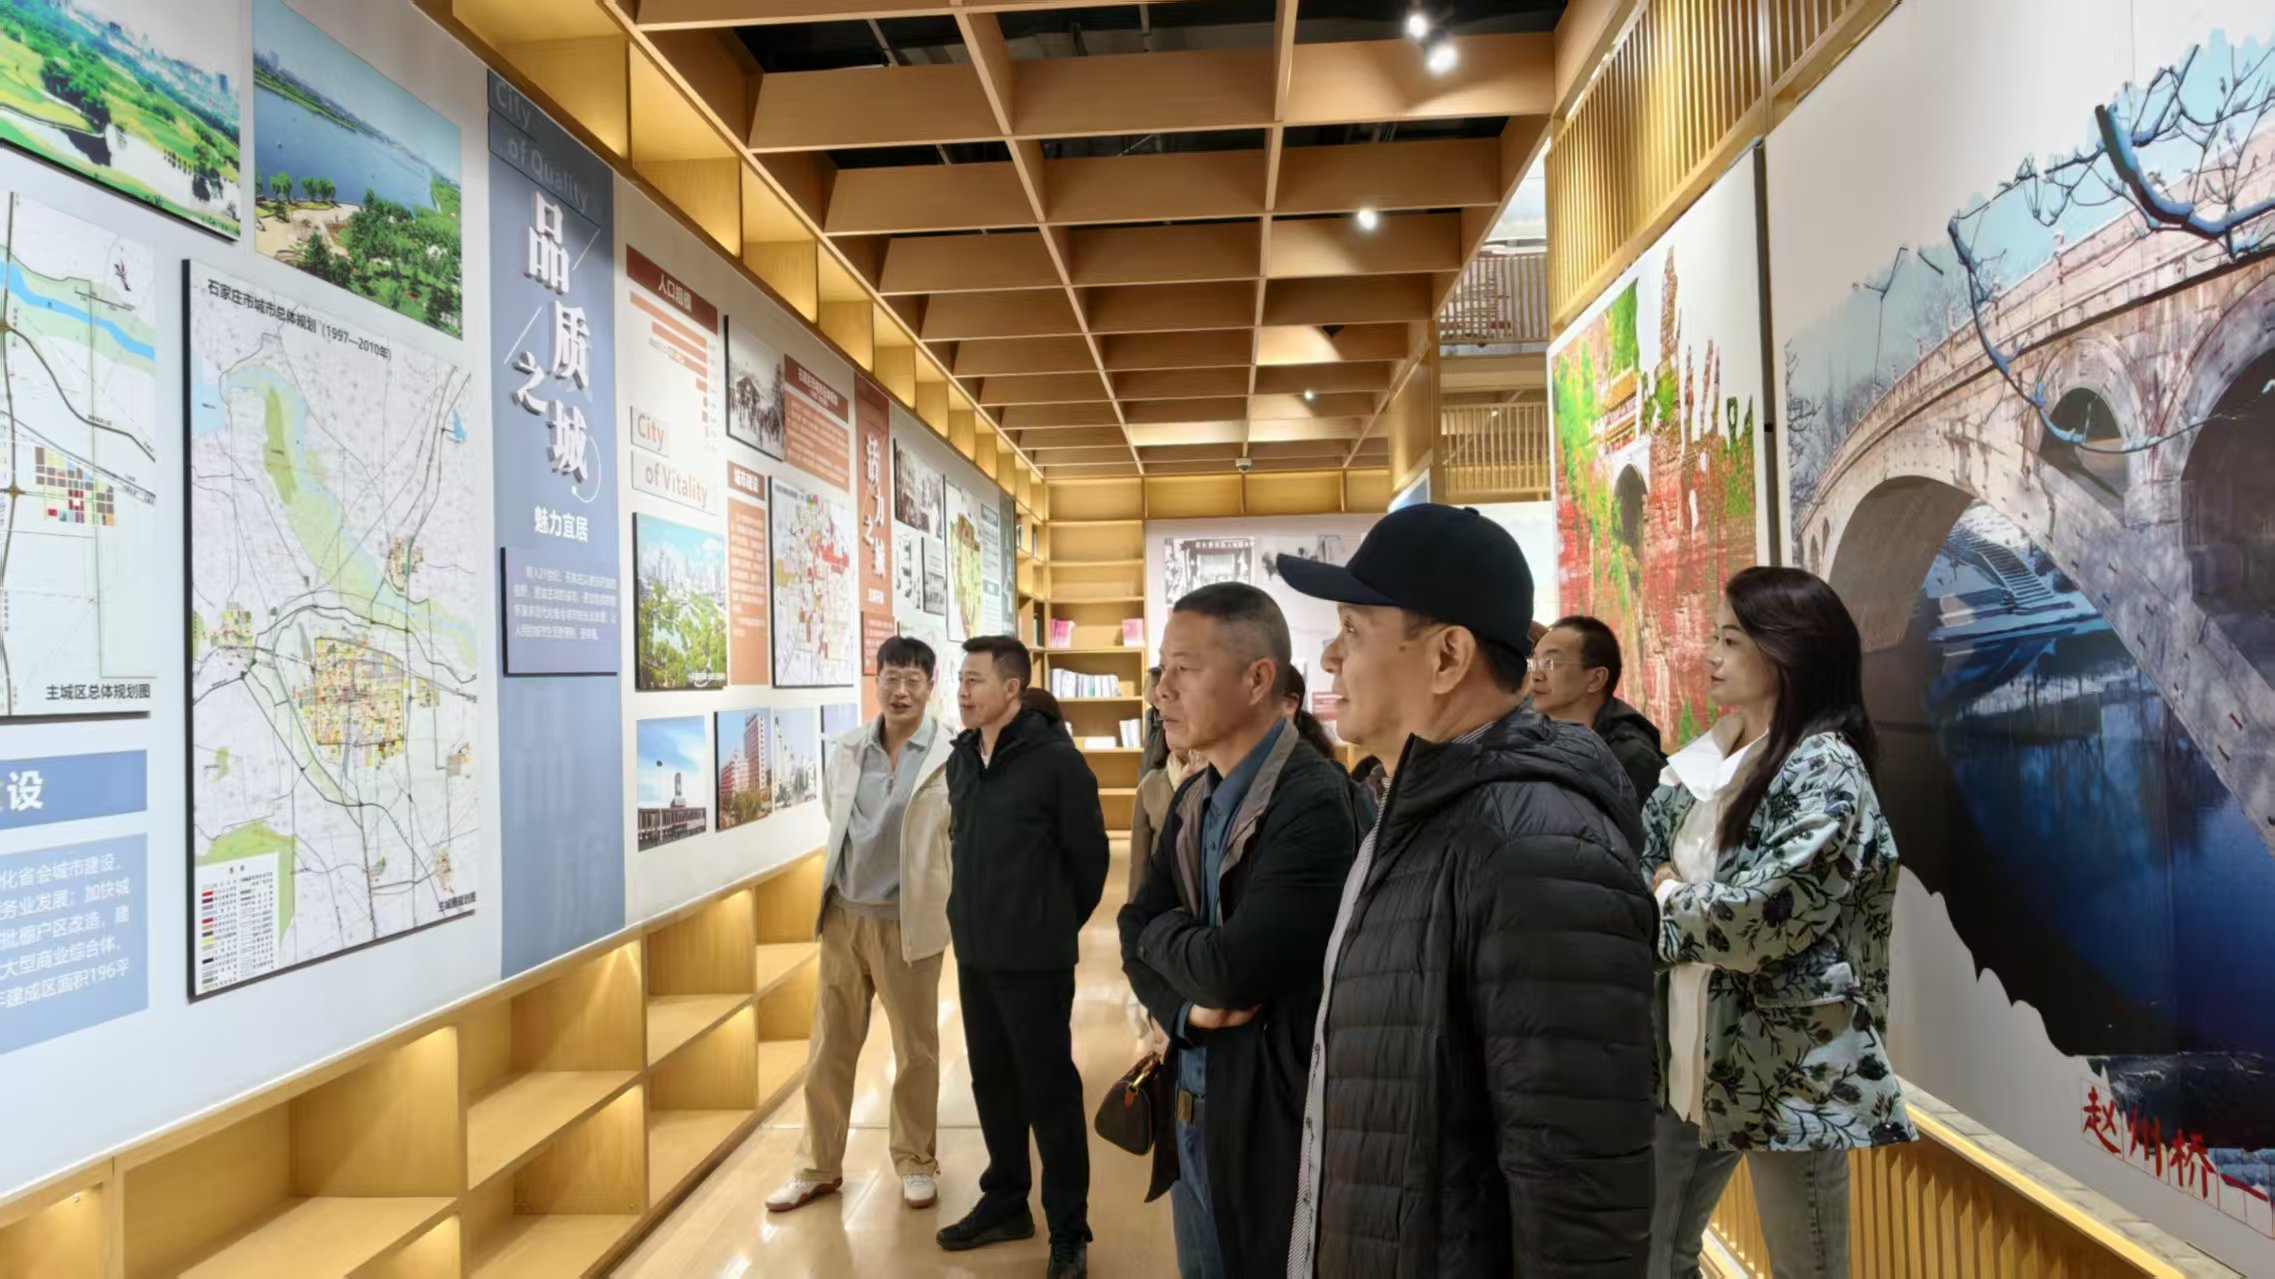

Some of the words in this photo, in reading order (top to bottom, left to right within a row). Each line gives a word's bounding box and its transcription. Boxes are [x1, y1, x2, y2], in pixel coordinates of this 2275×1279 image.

[495, 81, 531, 130] City
[508, 138, 526, 164] of
[531, 150, 589, 213] Quality
[637, 413, 664, 451] City
[645, 462, 660, 487] of
[662, 466, 708, 508] Vitality
[534, 505, 589, 542] 魅力宜居
[45, 683, 151, 701] 主城区总体规划图
[0, 770, 44, 812] 设
[0, 958, 130, 1008] 建成区面积196平
[2083, 1086, 2268, 1201] 赵州桥
